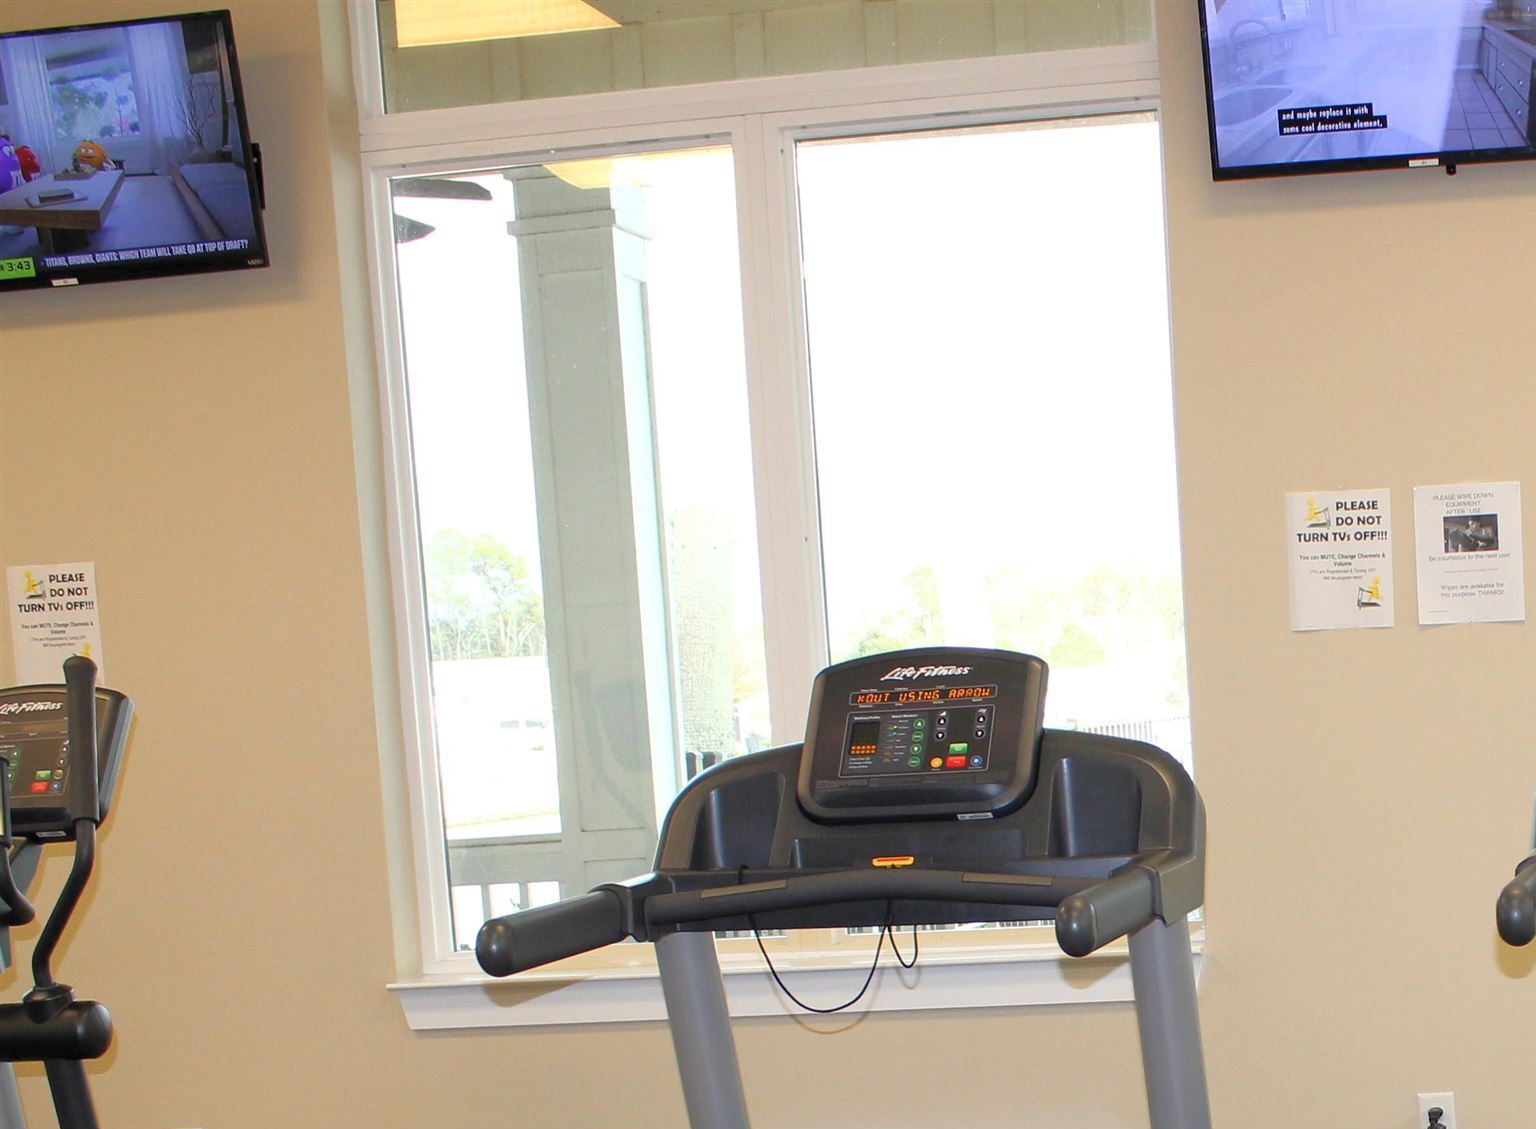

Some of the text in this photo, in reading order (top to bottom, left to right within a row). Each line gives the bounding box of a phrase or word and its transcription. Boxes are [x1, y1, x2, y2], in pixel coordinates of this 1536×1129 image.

[1282, 105, 1368, 120] and maybe replace it with
[1317, 121, 1351, 131] decorative
[120, 251, 138, 261] WHICH
[139, 249, 156, 259] TEAM
[156, 248, 171, 257] WILL
[172, 246, 186, 256] TAKE
[196, 244, 203, 253] AT
[205, 243, 217, 252] TOP
[217, 242, 225, 251] OF
[226, 239, 248, 250] DRAFT?
[8, 261, 31, 272] 3:43
[1336, 501, 1378, 511] PLEASE
[1336, 516, 1382, 526] DO NOT
[1297, 531, 1387, 542] TURN TVs OFF!!!
[49, 573, 84, 583] PLEASE
[50, 587, 88, 597] DO NOT
[18, 601, 94, 612] TURN TVs OFF!!!
[899, 690, 940, 701] USING
[949, 688, 991, 698] ARROW
